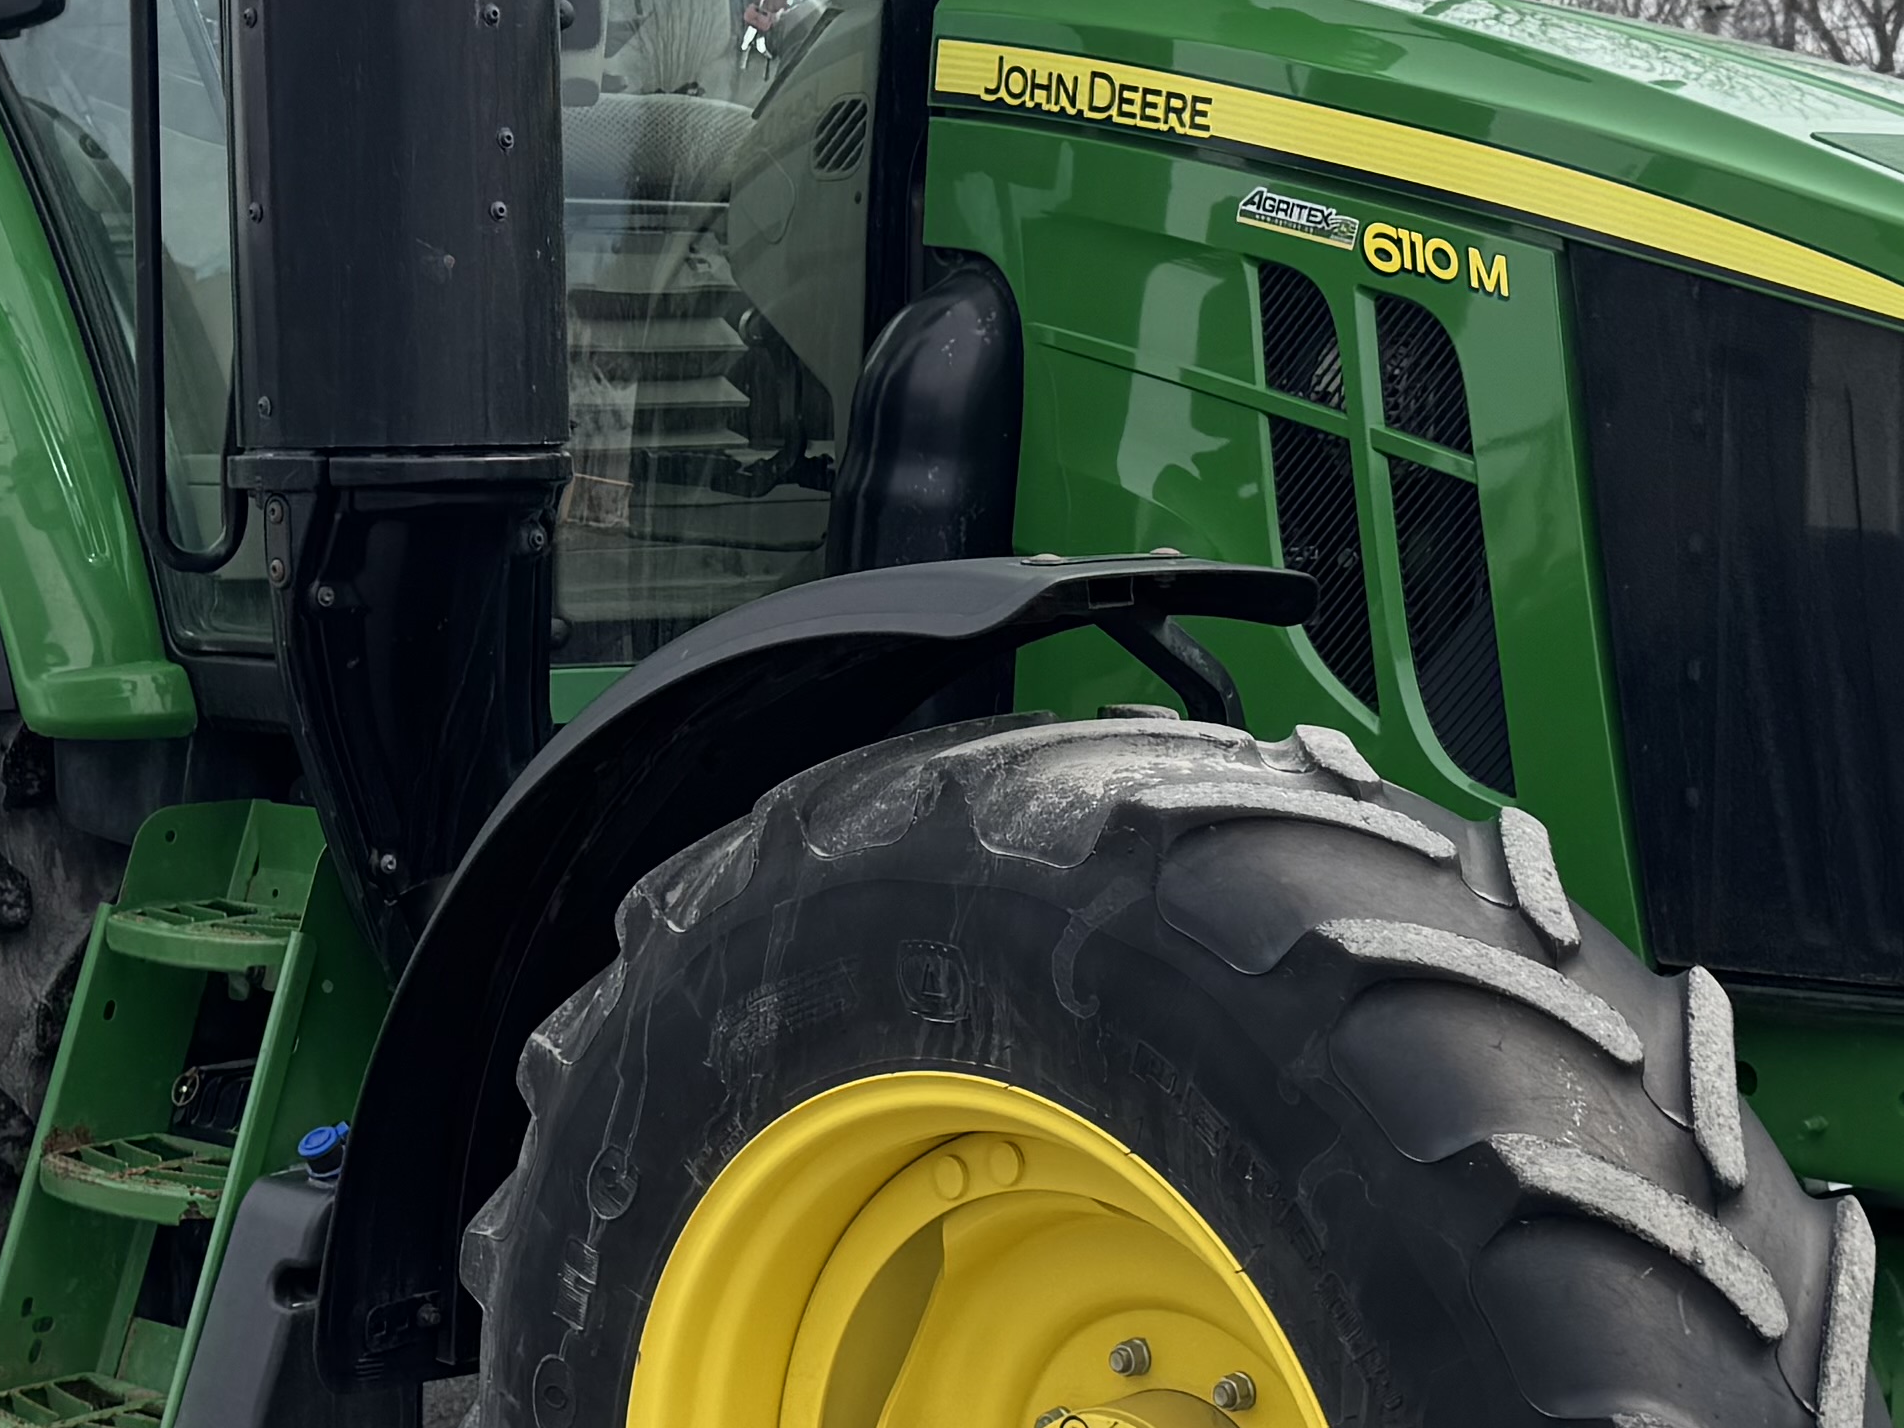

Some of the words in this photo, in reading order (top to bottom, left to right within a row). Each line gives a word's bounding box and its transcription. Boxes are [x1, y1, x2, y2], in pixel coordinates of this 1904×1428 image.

[983, 55, 1079, 110] JOHN
[1087, 71, 1213, 133] DEERE
[1242, 190, 1333, 228] AGRITEX
[1363, 222, 1459, 280] 6110
[1467, 246, 1510, 298] M
